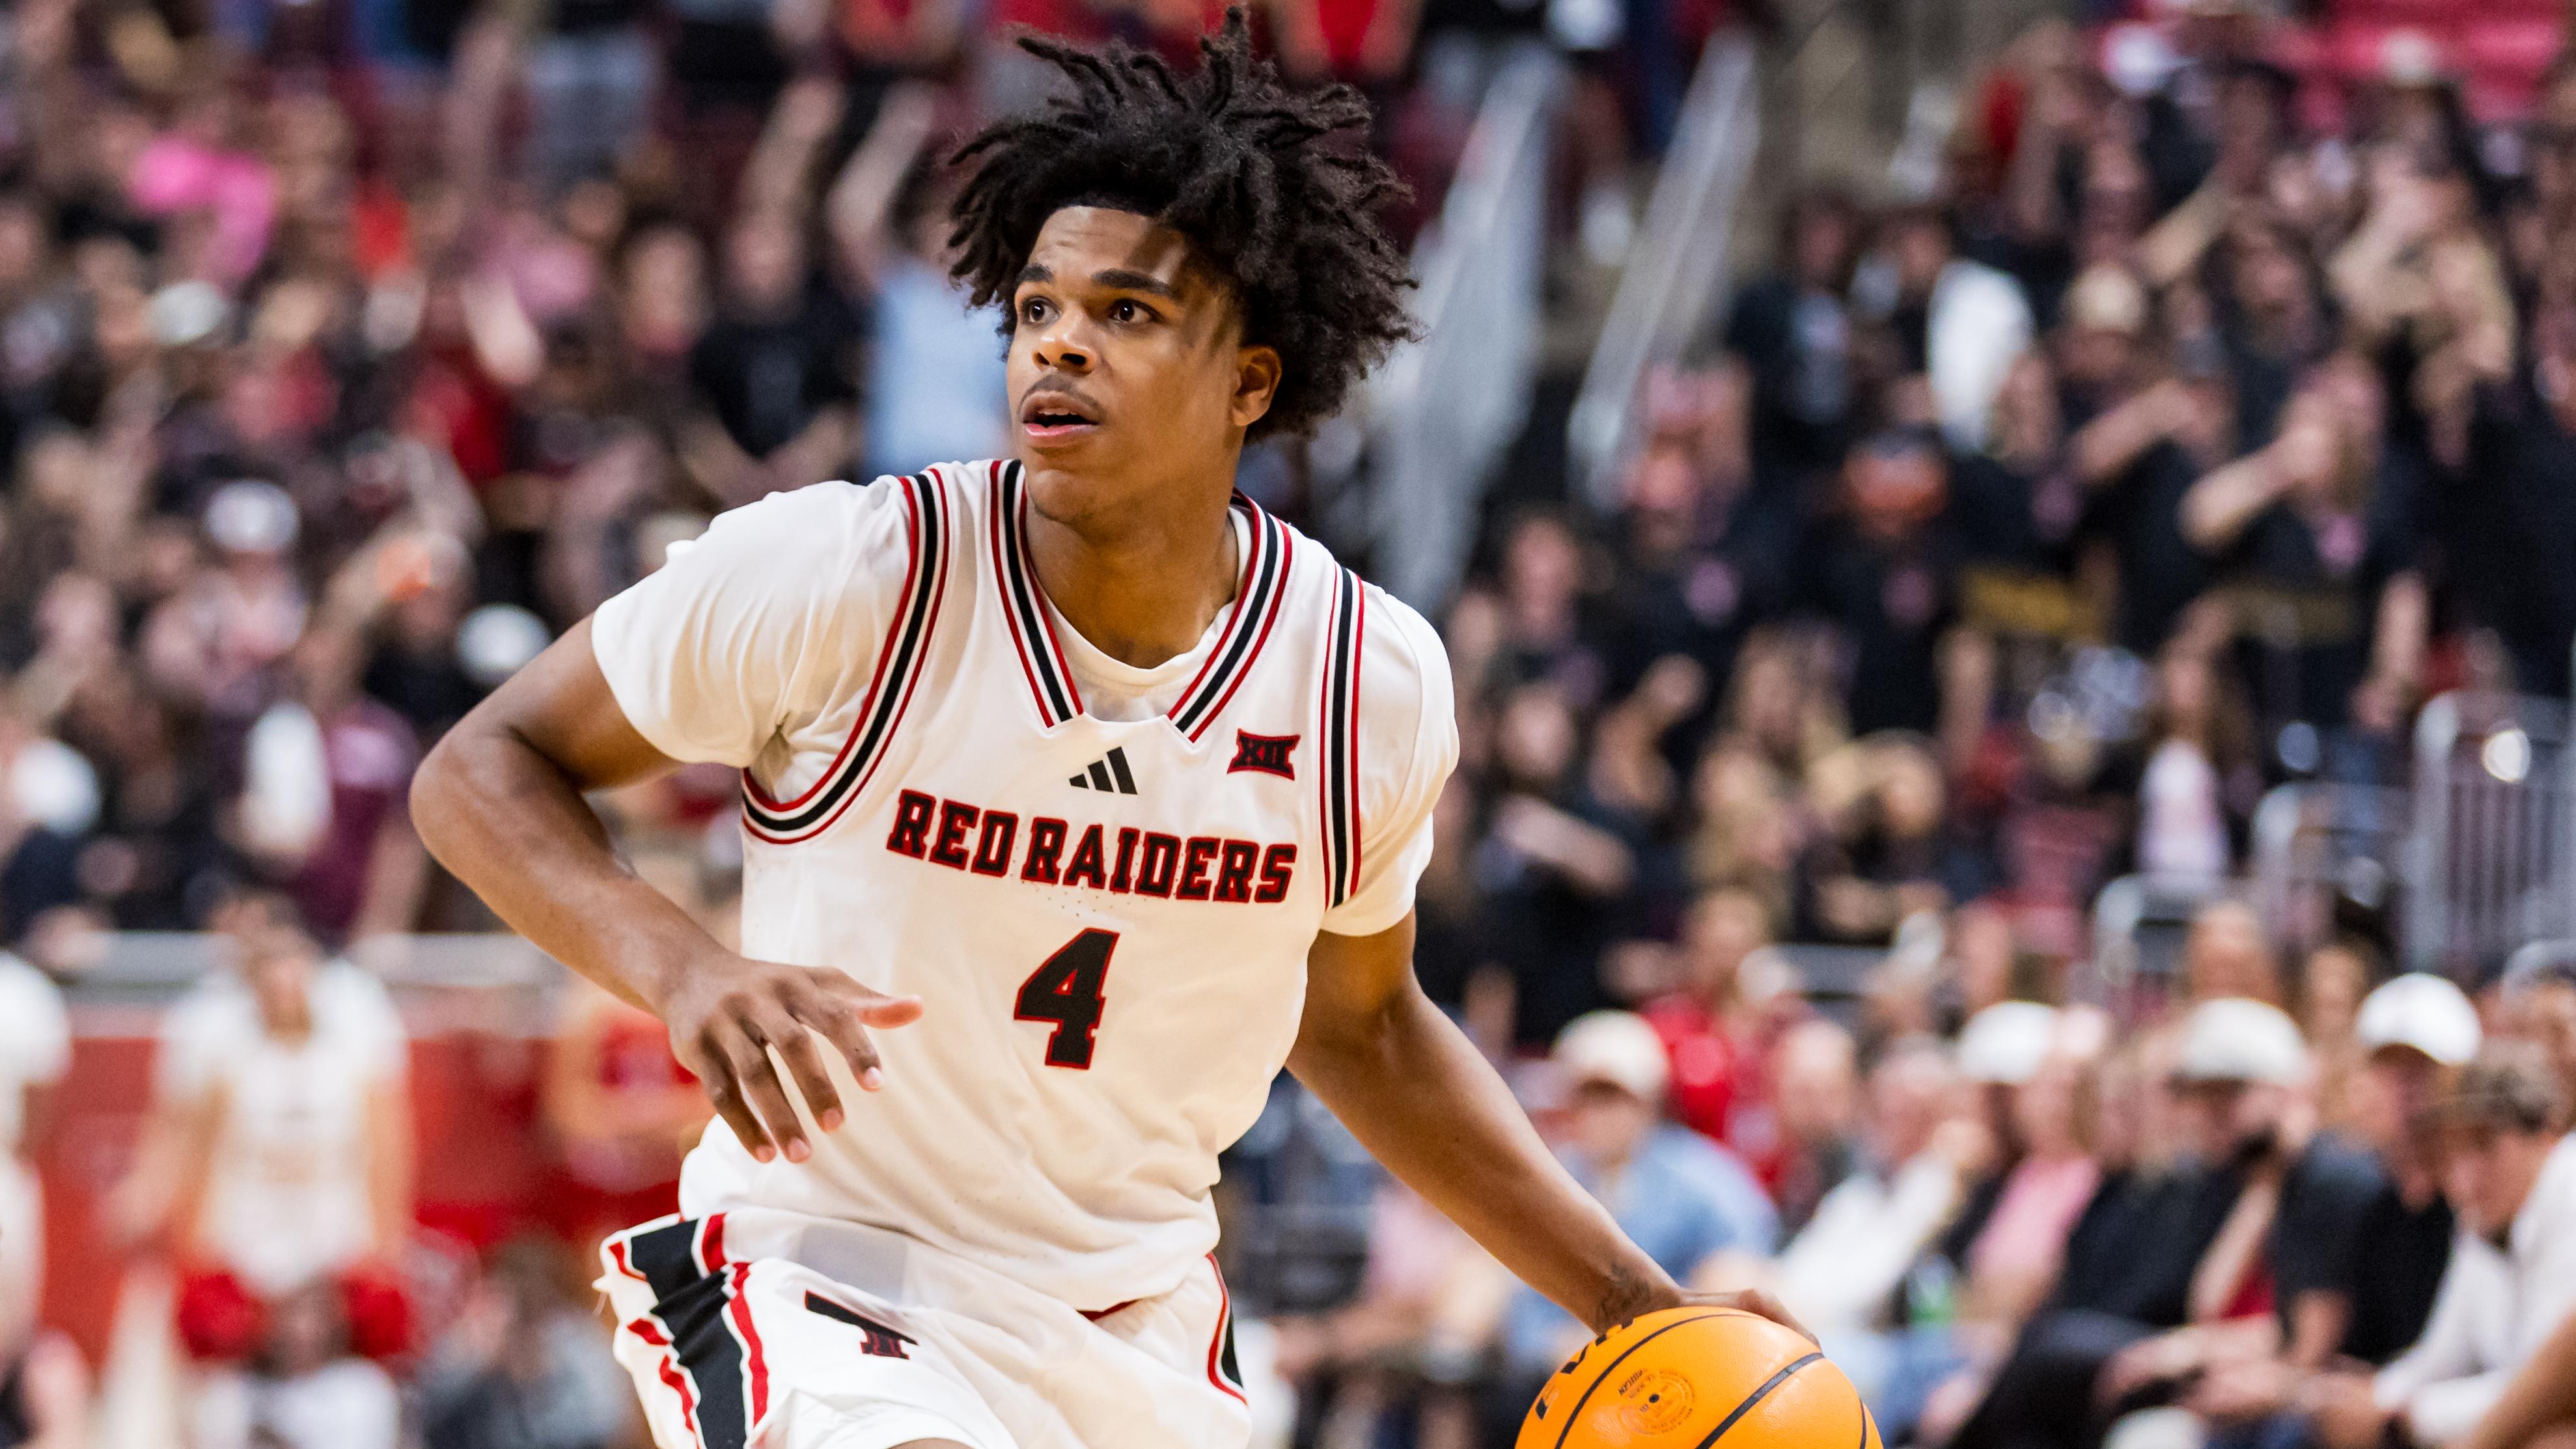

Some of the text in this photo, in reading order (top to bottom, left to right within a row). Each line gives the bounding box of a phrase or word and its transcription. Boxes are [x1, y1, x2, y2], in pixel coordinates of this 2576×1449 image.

[886, 788, 1298, 904] RED RAIDERS
[1013, 927, 1120, 1070] 4
